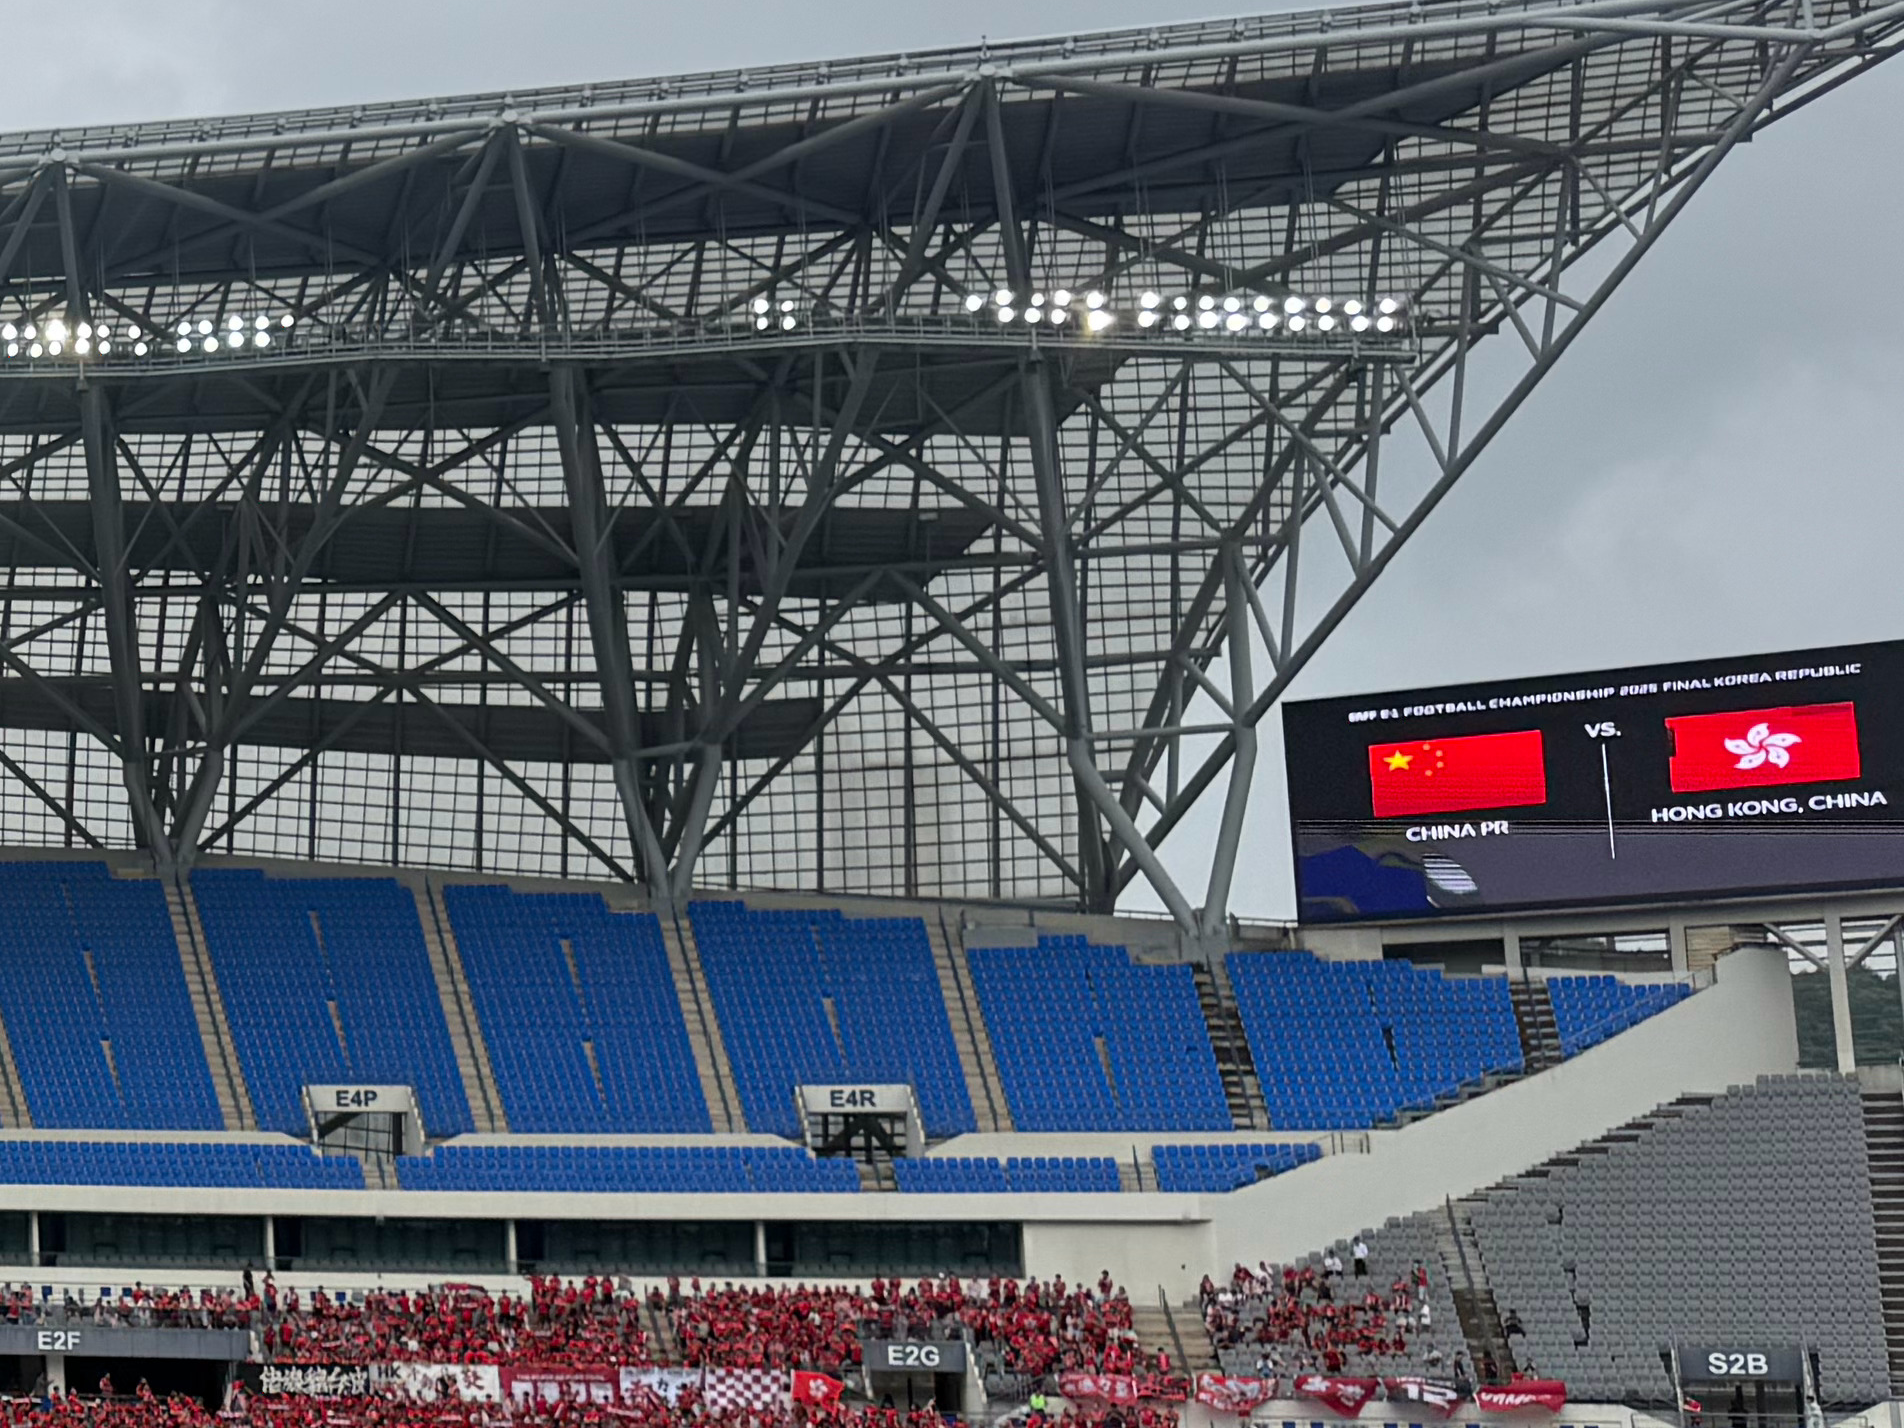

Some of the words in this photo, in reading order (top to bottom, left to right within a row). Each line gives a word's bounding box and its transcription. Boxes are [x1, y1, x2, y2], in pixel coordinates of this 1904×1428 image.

[1403, 700, 1486, 717] FOOTBALL
[1489, 687, 1615, 709] CHAMPIONSHIP
[1663, 679, 1711, 691] FINAL
[1714, 672, 1772, 687] KOREA
[1775, 663, 1861, 680] REPUBLIC
[1584, 721, 1621, 738] VS.
[1651, 803, 1723, 822] HONG
[1808, 791, 1888, 810] CHINA
[1405, 823, 1476, 841] CHINA
[1480, 820, 1509, 836] PR
[336, 1089, 378, 1108] E4P
[829, 1089, 876, 1108] E4R
[38, 1331, 80, 1351] E2F
[888, 1345, 940, 1366] E2G
[1708, 1351, 1768, 1375] S2B
